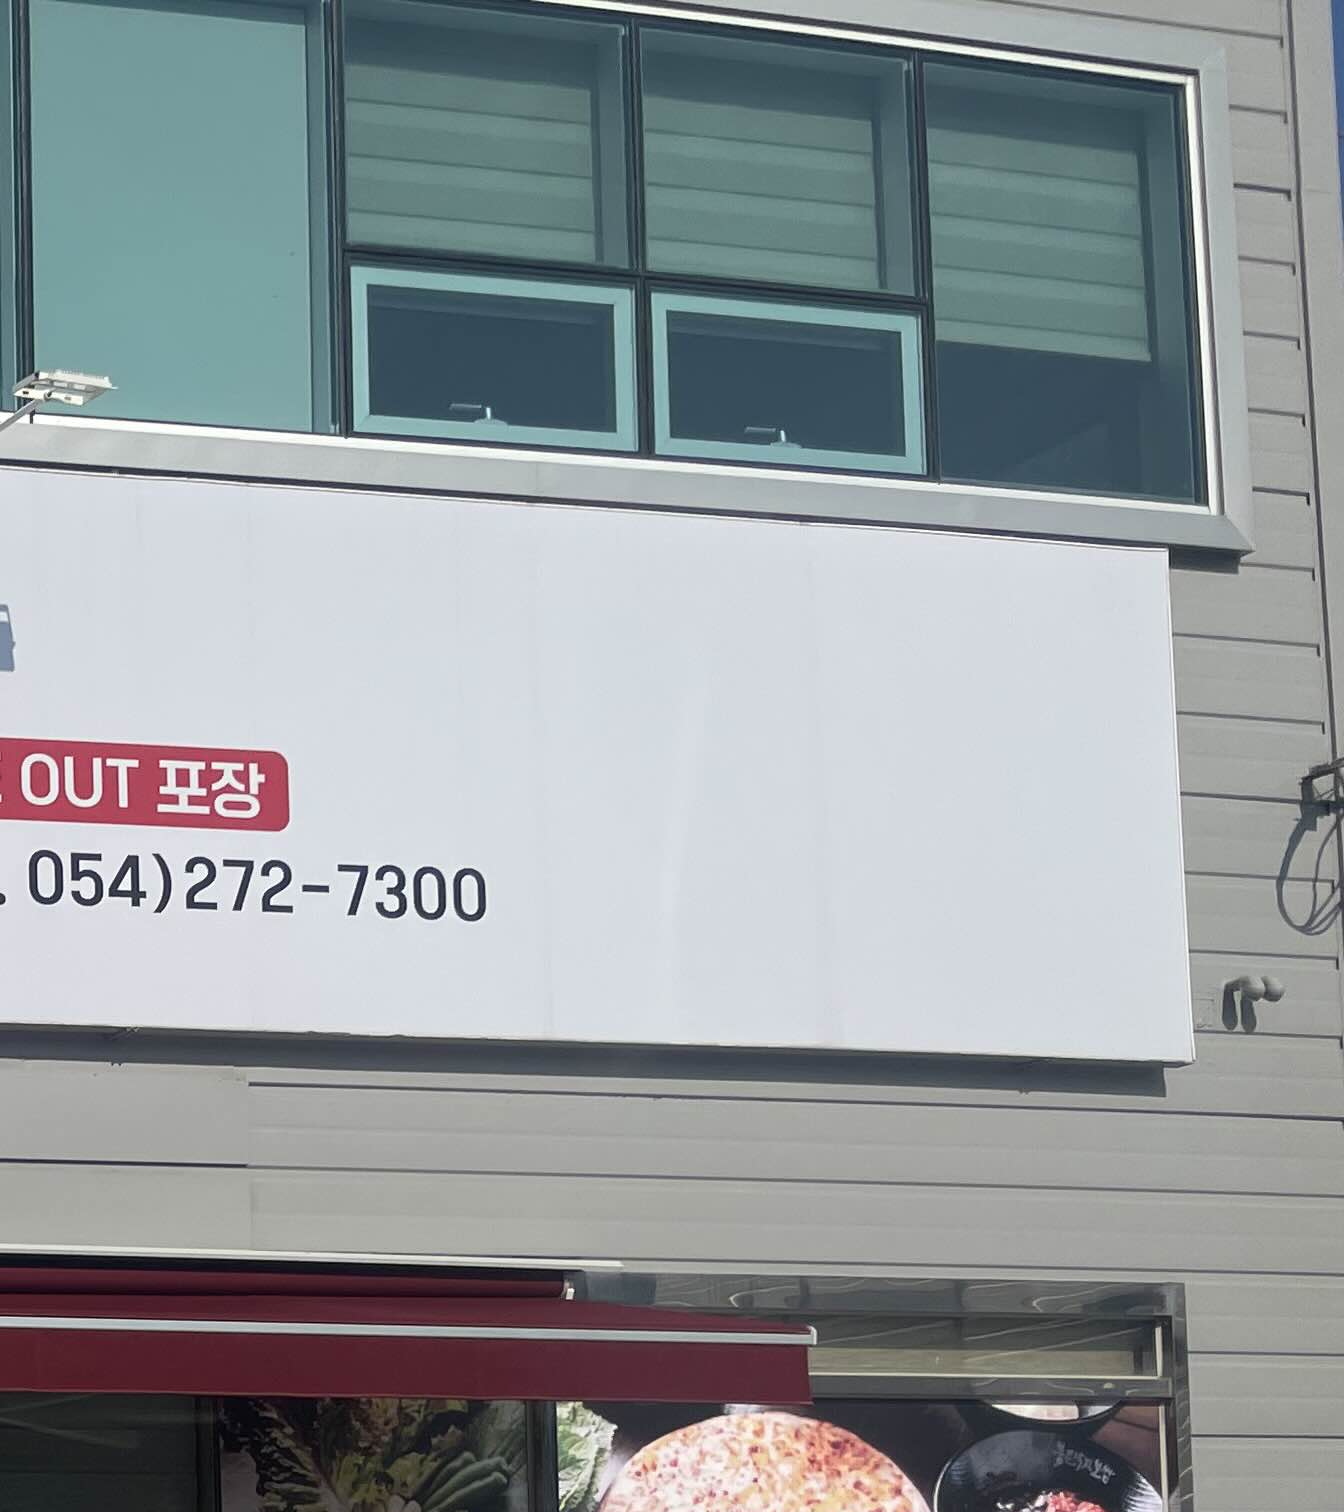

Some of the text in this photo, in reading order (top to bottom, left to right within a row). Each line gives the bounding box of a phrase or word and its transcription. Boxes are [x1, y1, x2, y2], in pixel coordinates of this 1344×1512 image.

[21, 753, 139, 808] OUT
[157, 759, 266, 819] 포장
[28, 849, 488, 922] 054)272-7300
